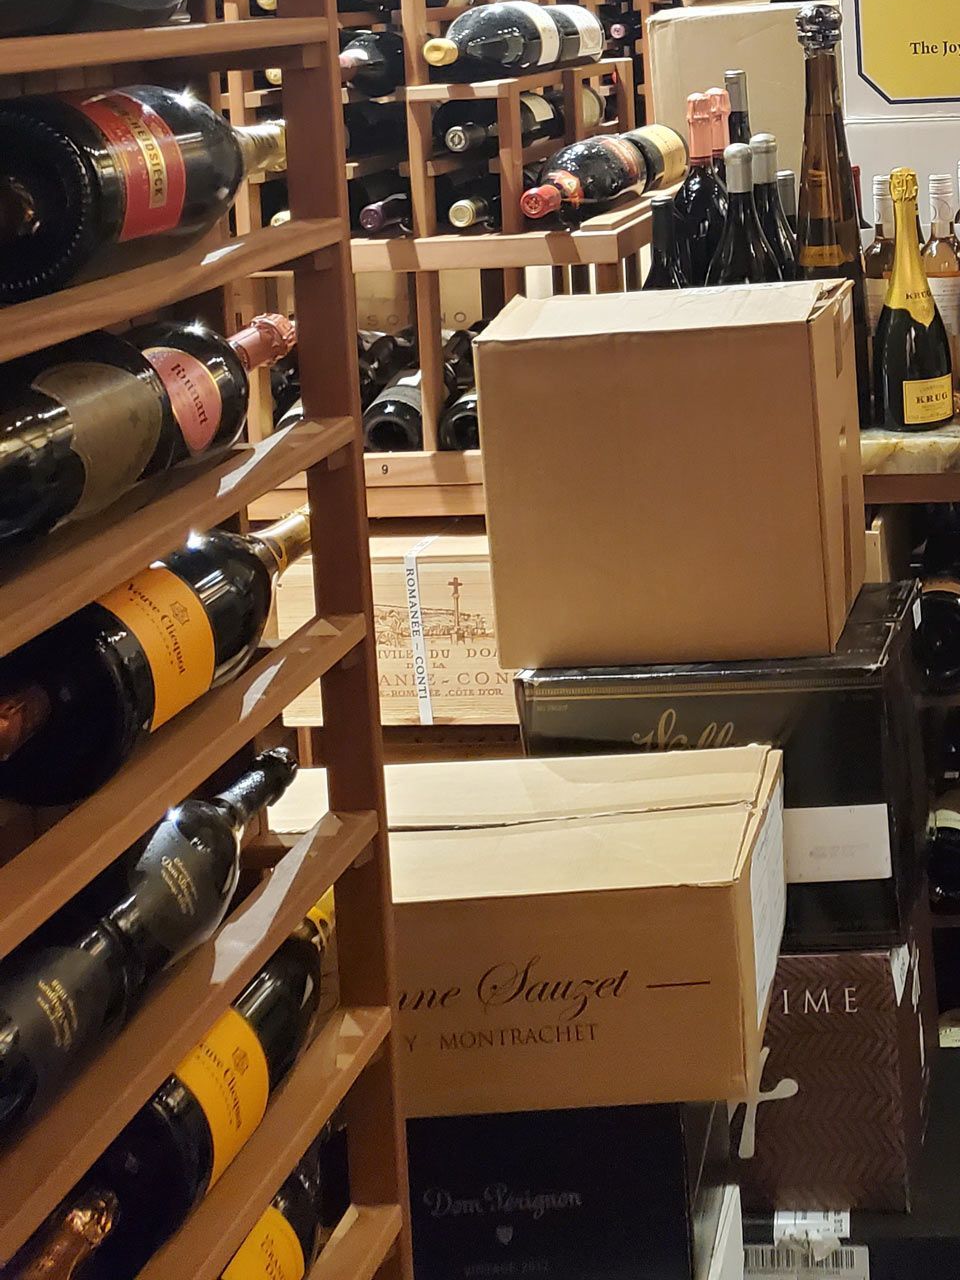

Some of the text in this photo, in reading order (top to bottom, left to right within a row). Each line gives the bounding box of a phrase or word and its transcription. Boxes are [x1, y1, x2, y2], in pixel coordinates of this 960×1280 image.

[909, 41, 939, 56] The
[905, 289, 932, 301] KRUG
[170, 363, 209, 425] Ruinart
[915, 391, 949, 404] KRUG
[381, 464, 389, 475] 9
[429, 648, 450, 659] DU
[414, 655, 428, 699] CONTI
[477, 955, 630, 1022] Sauzet
[439, 1022, 600, 1051] MONTRACHET
